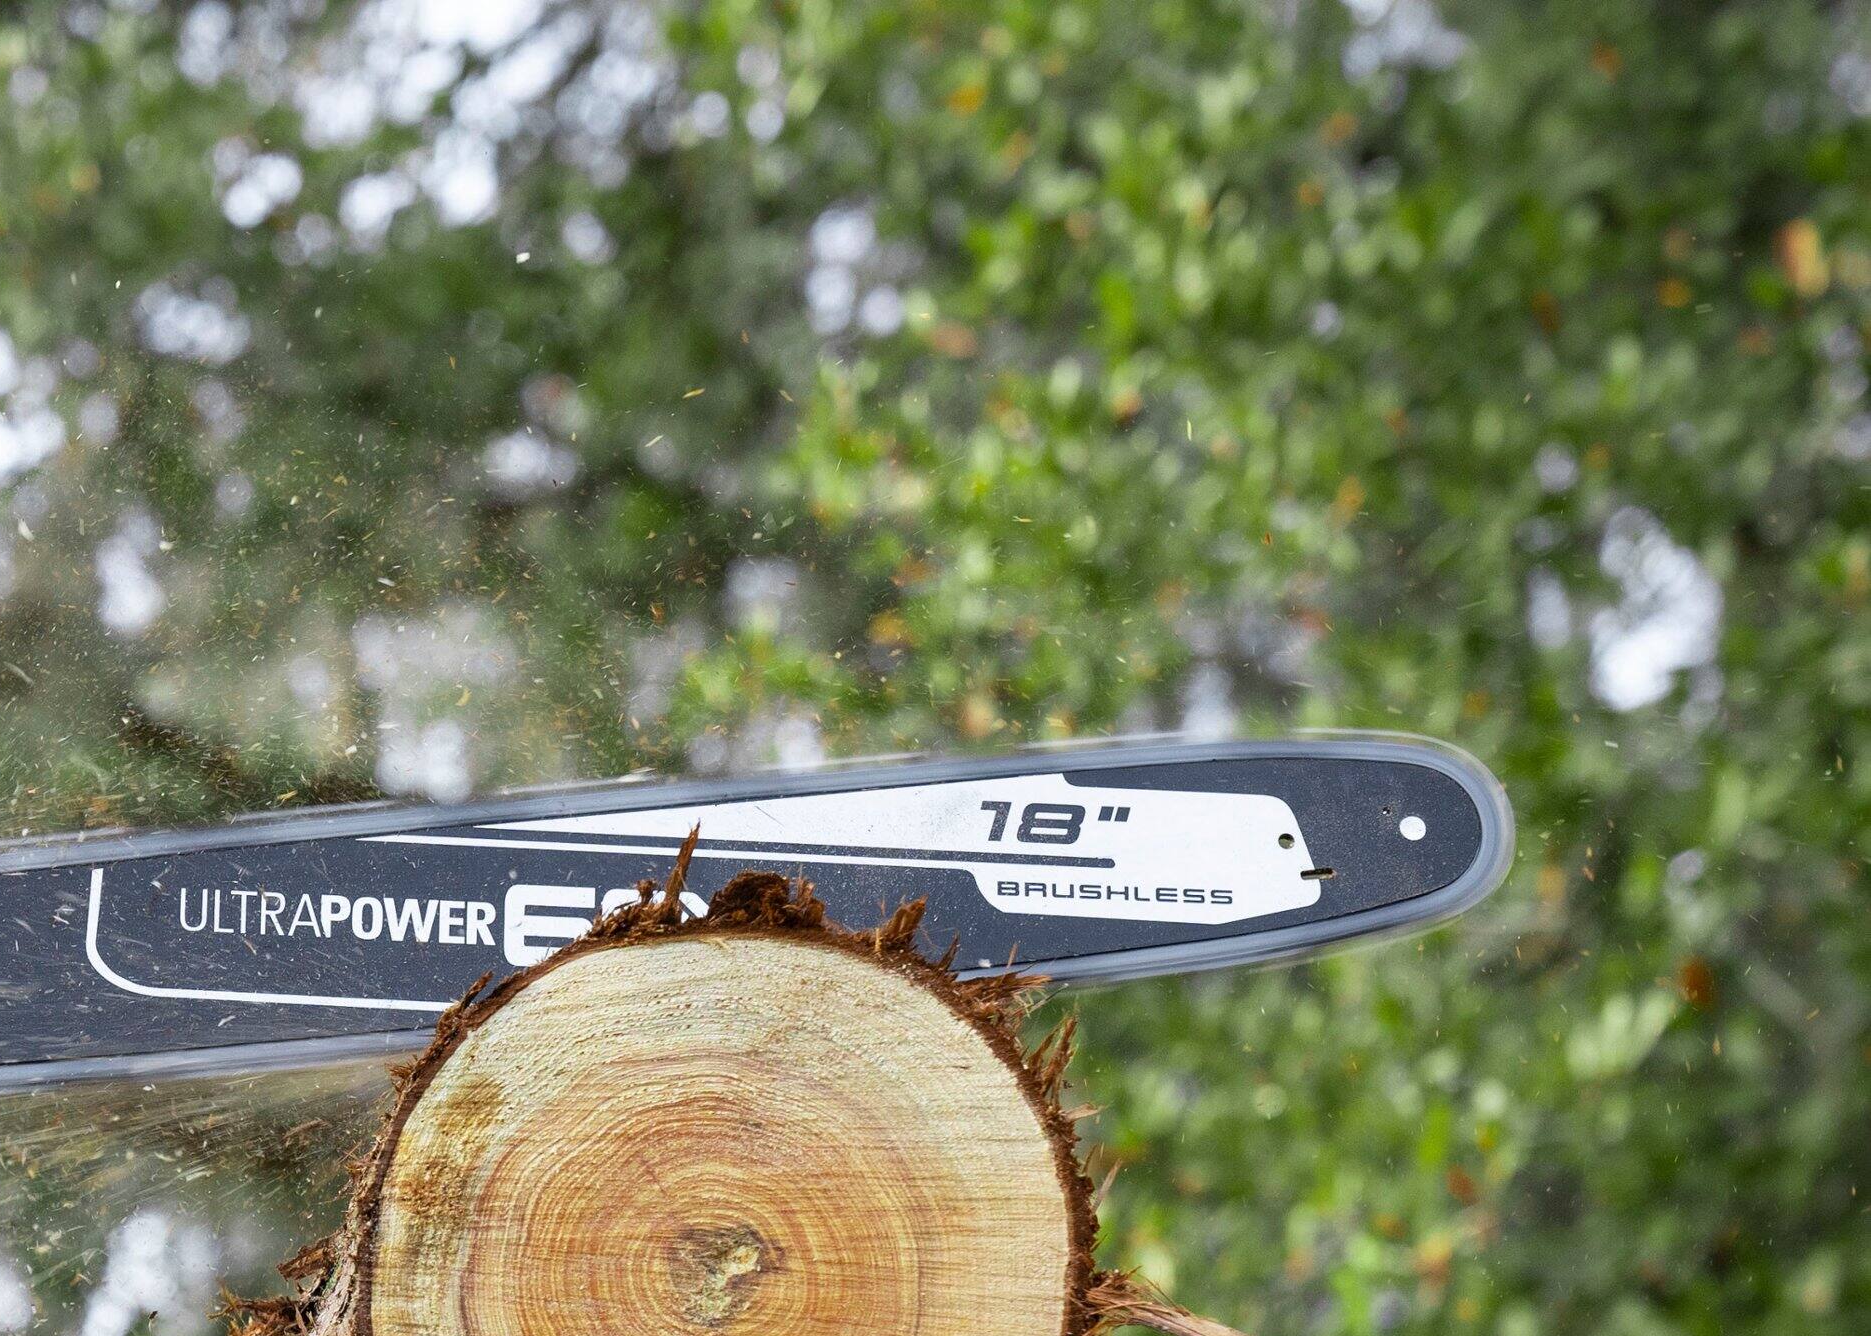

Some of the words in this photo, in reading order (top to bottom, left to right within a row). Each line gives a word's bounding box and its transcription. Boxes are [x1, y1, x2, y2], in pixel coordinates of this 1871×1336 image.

[980, 800, 1131, 844] 18"
[997, 881, 1233, 905] BRUSHLESS
[179, 887, 495, 946] ULTRAPOWER
